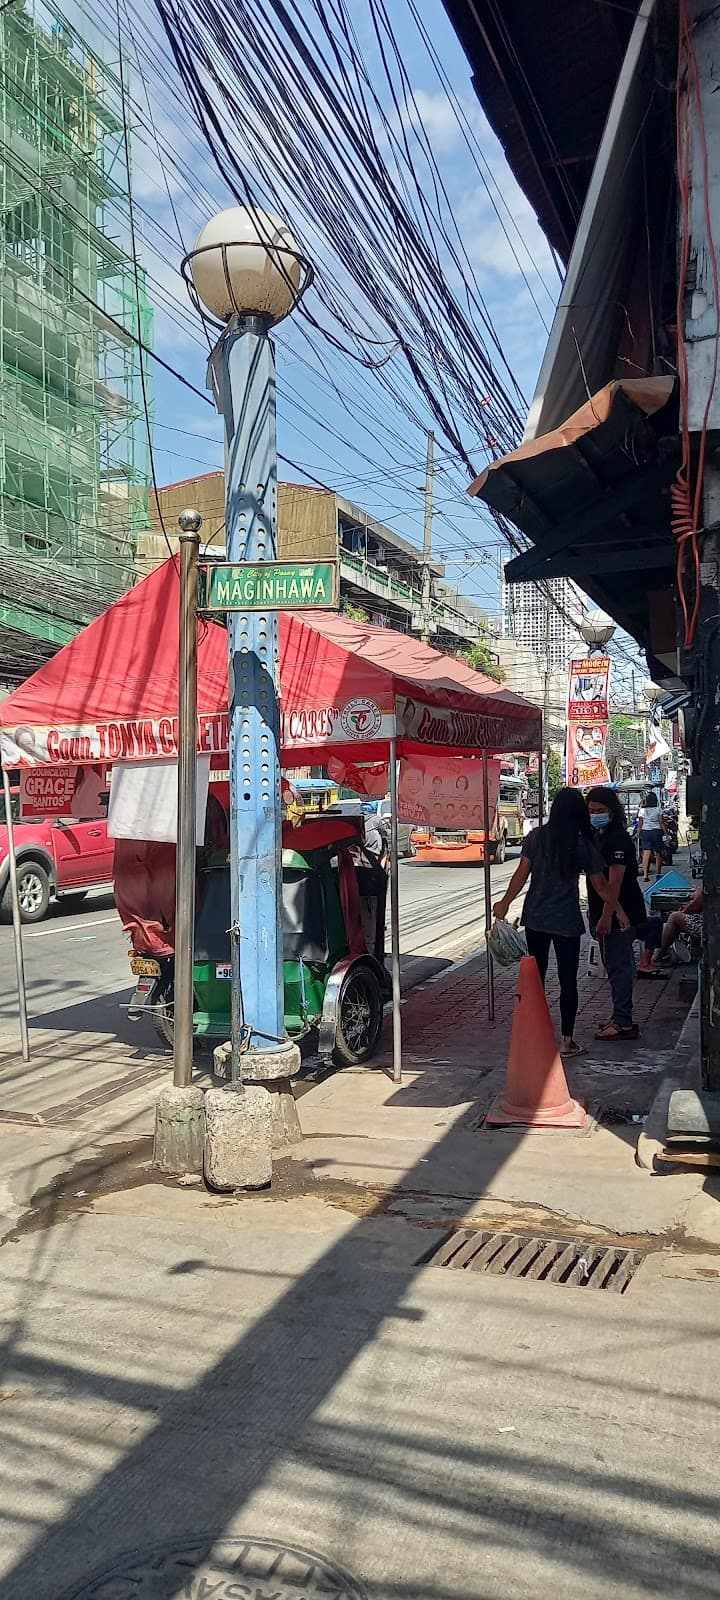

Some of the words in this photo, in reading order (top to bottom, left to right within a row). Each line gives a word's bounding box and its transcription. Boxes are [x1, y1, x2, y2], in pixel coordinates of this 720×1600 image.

[217, 578, 326, 600] MAGINHAWA
[582, 659, 608, 668] Modern
[47, 730, 95, 762] Coun.
[96, 720, 157, 758] TONYA
[159, 715, 229, 755] CETA
[31, 768, 69, 777] COUNCILOR
[25, 777, 75, 795] GRACE
[33, 796, 65, 808] SANTOS
